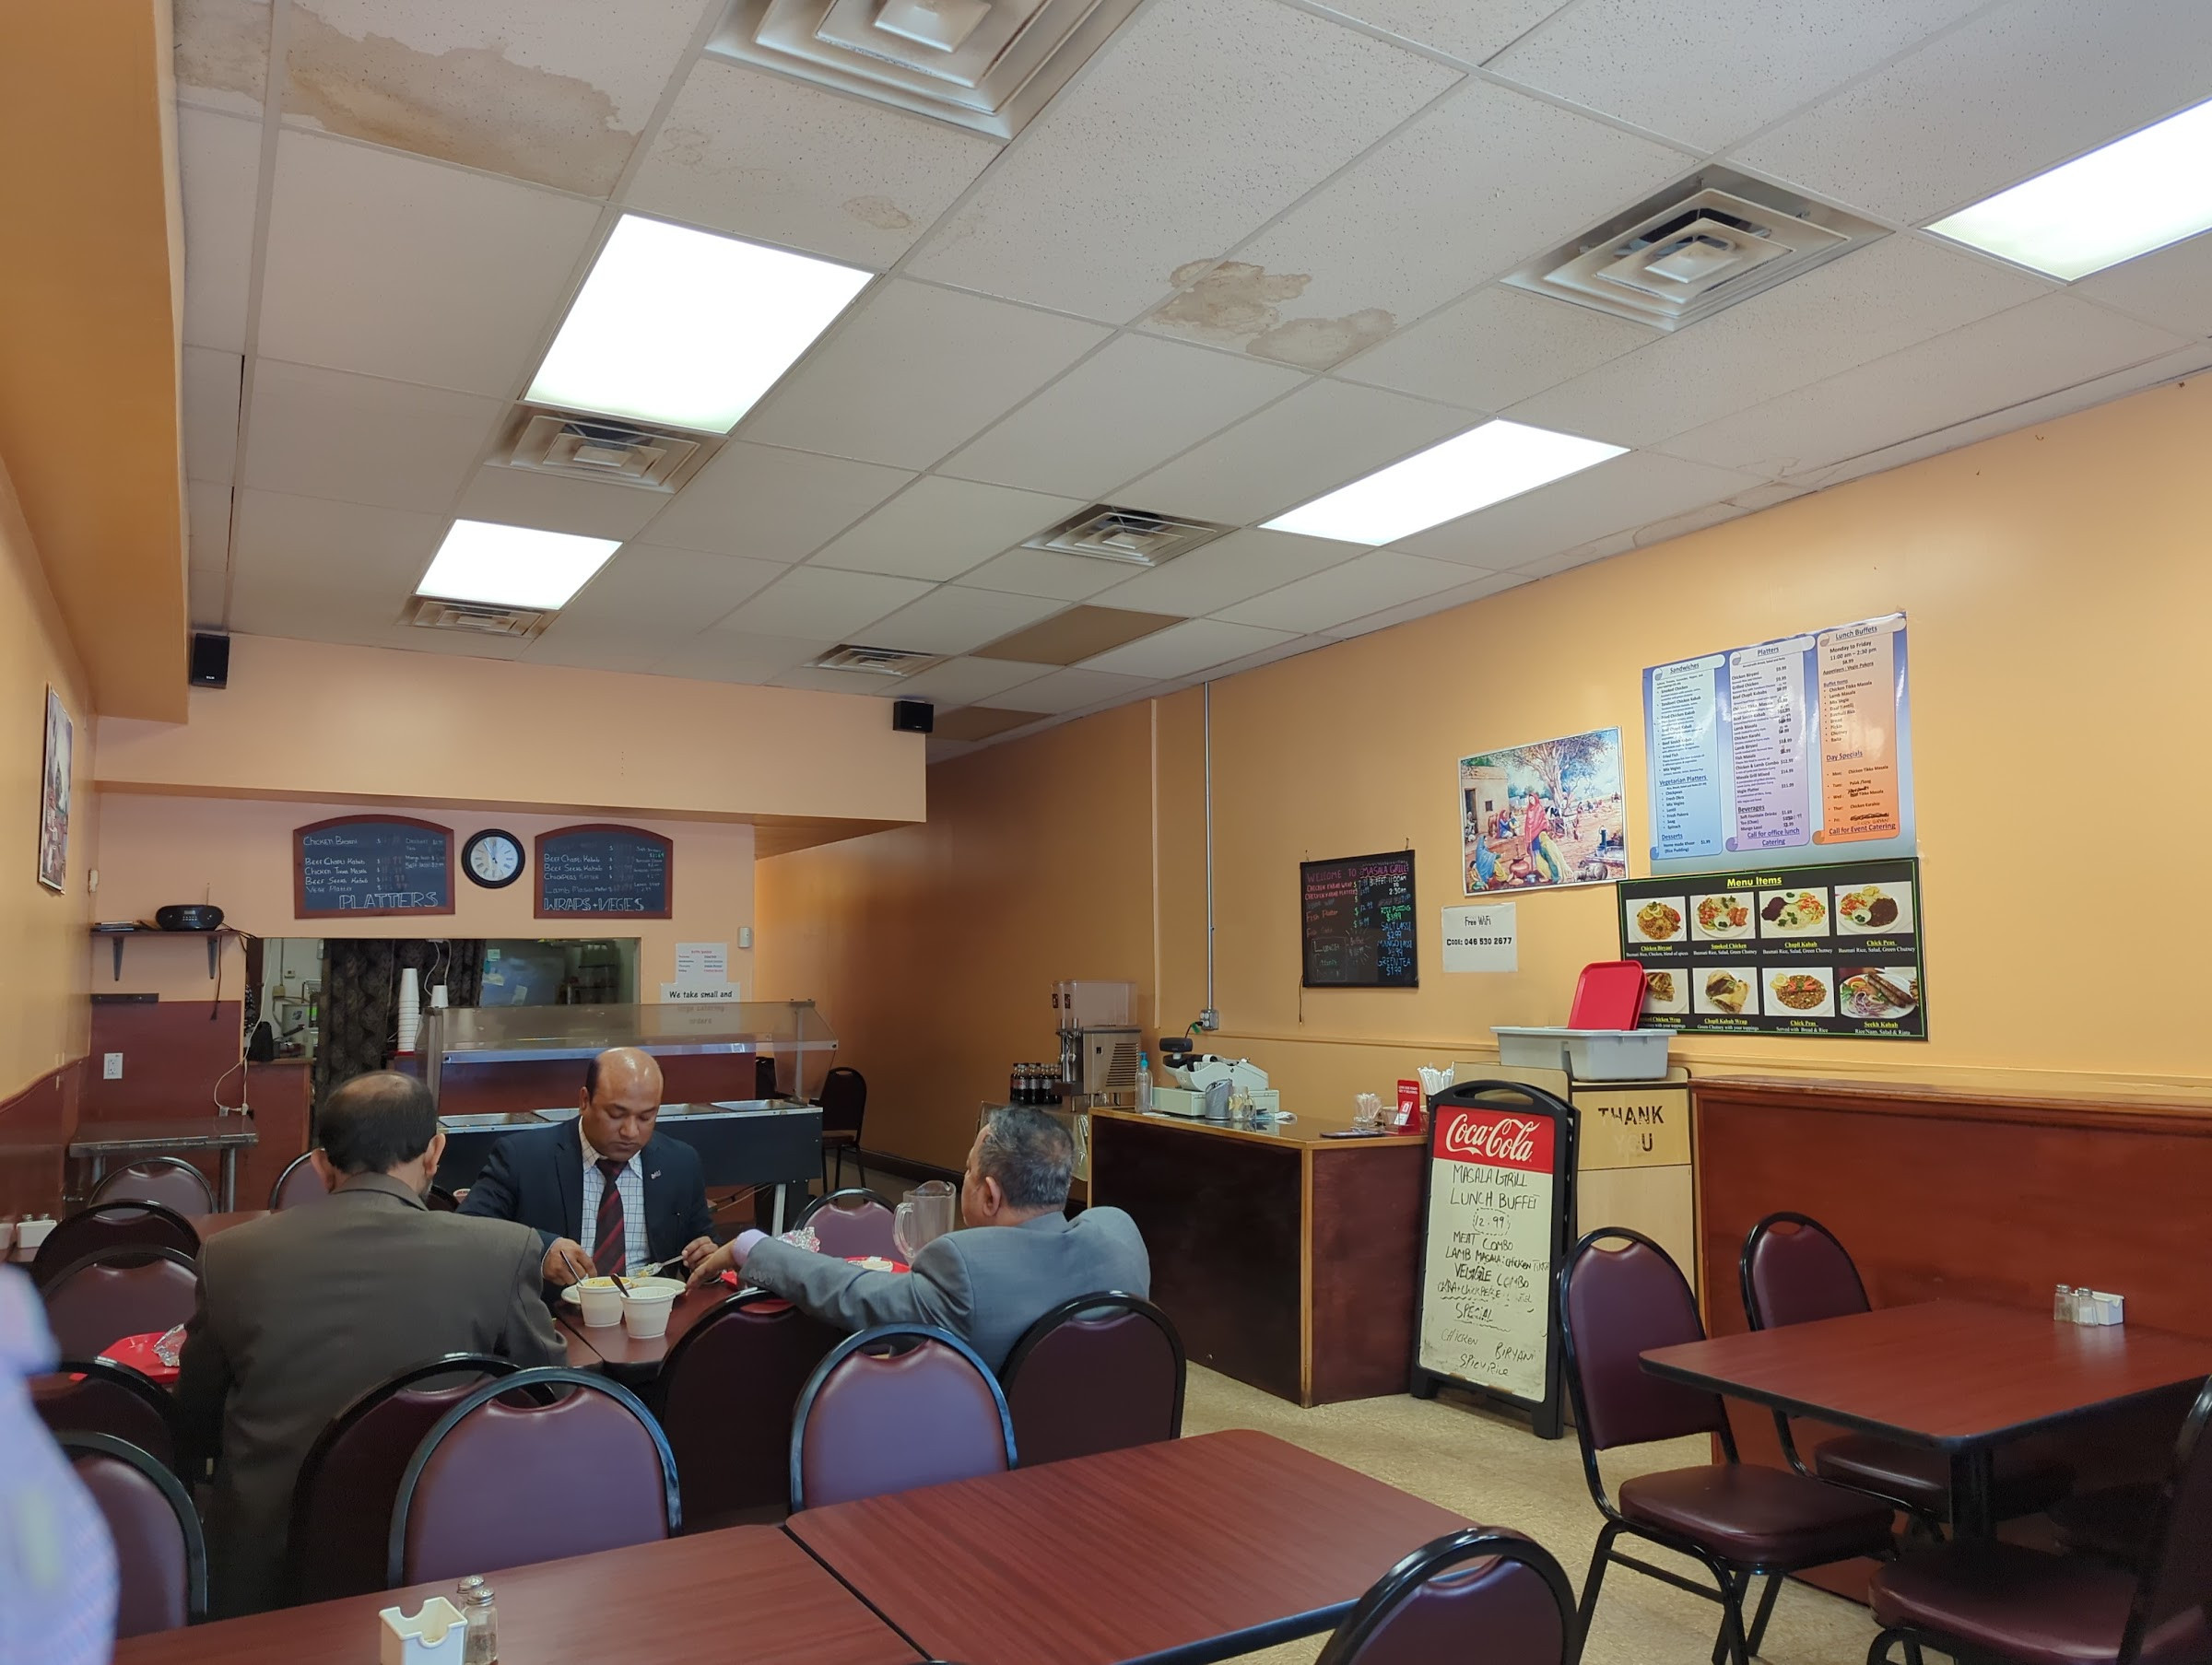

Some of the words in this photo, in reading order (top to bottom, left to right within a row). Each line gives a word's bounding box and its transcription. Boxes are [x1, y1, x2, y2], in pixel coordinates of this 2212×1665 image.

[1836, 632, 1853, 640] Lunch
[1854, 627, 1877, 637] Buffets
[1758, 647, 1779, 655] Platters
[1670, 663, 1700, 674] Sandwiches
[1840, 751, 1863, 759] Specials
[1659, 778, 1686, 786] Vegetarian
[1348, 868, 1356, 877] TO
[1363, 865, 1387, 875] MASALA
[1727, 878, 1753, 887] Menu
[1755, 875, 1782, 885] Items
[339, 892, 438, 909] PLATTERS
[1465, 916, 1477, 926] Free
[1598, 1106, 1664, 1125] THANK
[1446, 1114, 1540, 1161] Coca-Cola
[1453, 1165, 1492, 1183] MASALA
[1451, 1188, 1492, 1206] LUNCH
[1500, 1193, 1540, 1209] BUFFET
[1475, 1216, 1504, 1228] 12.99
[1453, 1232, 1480, 1245] MEAT
[1483, 1238, 1513, 1250] COMBO
[1446, 1246, 1471, 1260] LAMB
